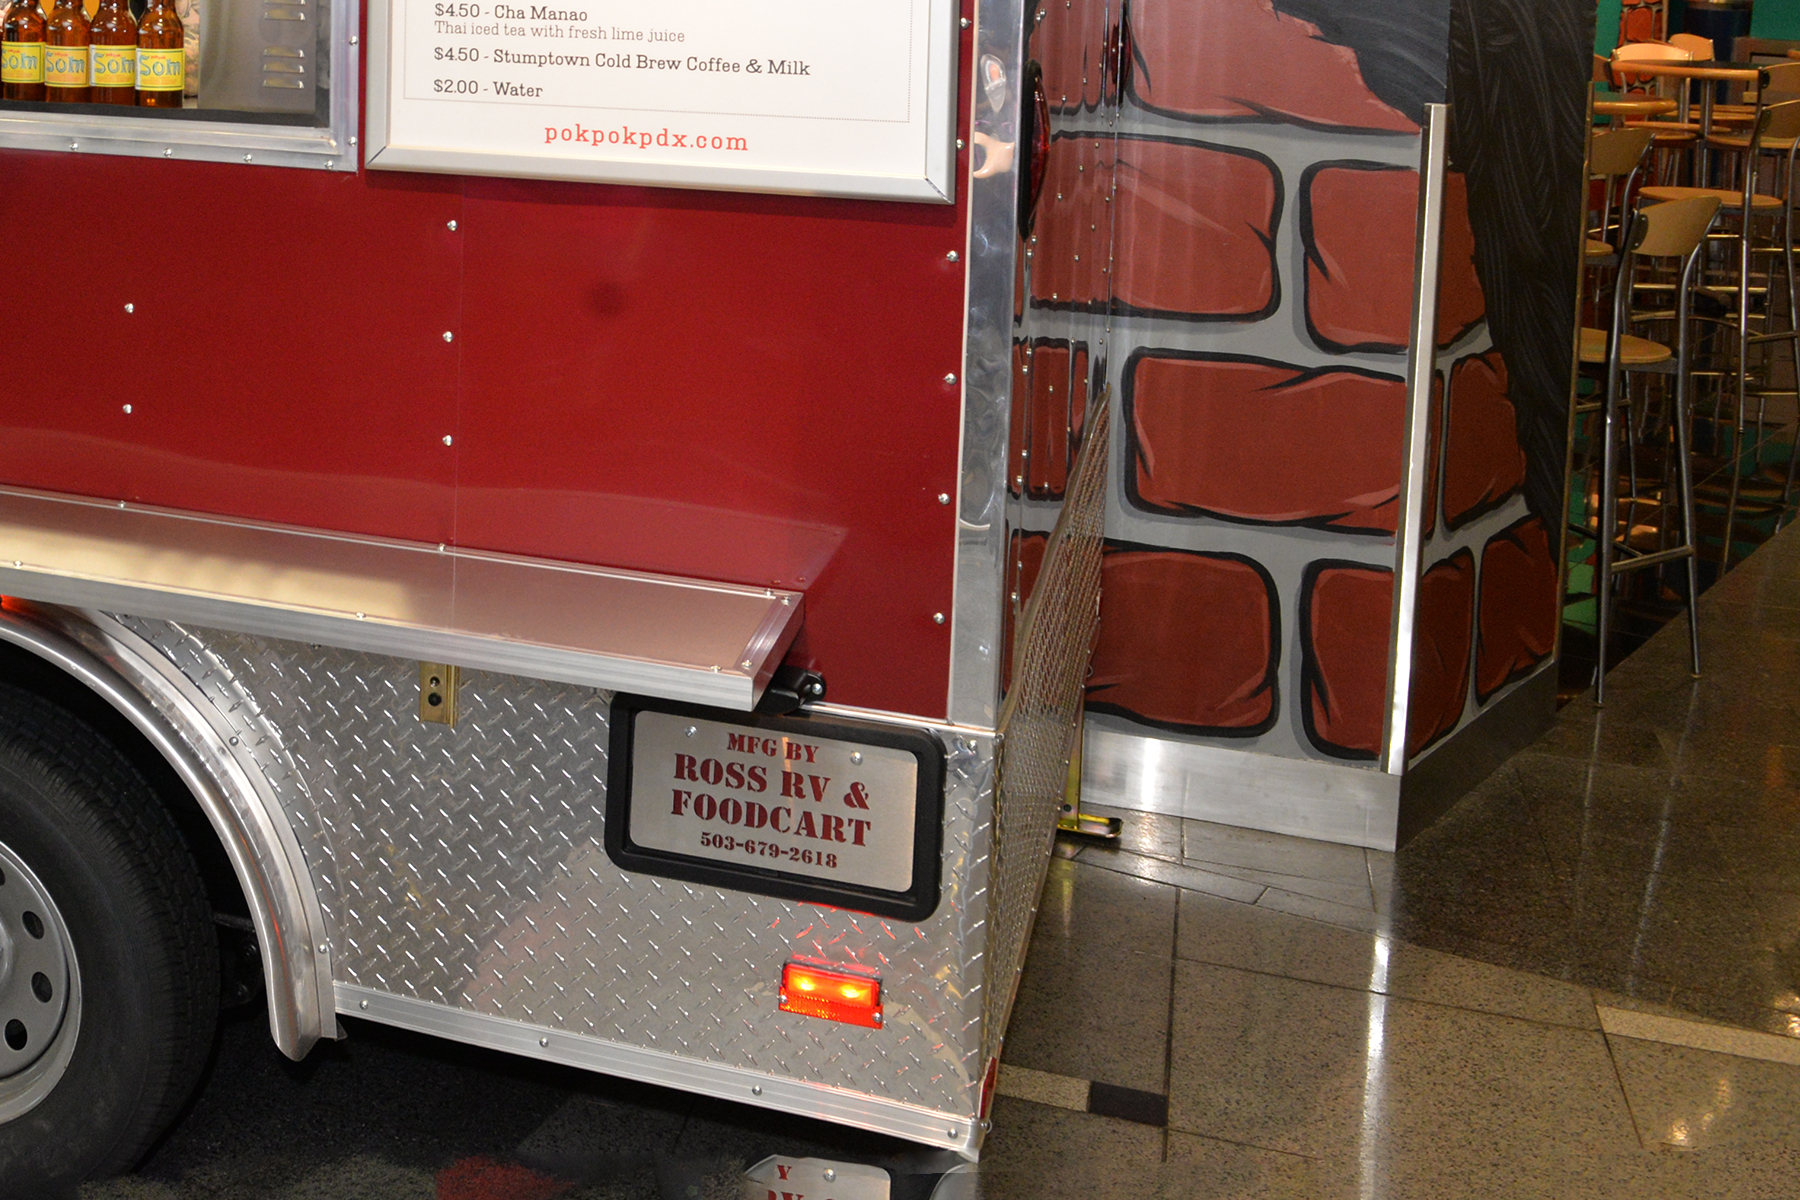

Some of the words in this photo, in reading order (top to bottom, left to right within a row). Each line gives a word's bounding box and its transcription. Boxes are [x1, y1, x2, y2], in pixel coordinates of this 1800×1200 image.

[433, 2, 480, 19] $4.50
[493, 3, 526, 20] Cha
[529, 4, 588, 22] Manao
[433, 19, 468, 35] Thai
[470, 21, 500, 36] iced
[502, 22, 527, 37] tea
[529, 23, 564, 39] with
[567, 23, 608, 40] fresh
[610, 25, 644, 42] lime
[646, 28, 685, 43] juice
[45, 51, 85, 73] Som
[93, 52, 136, 74] Som
[139, 54, 181, 76] Som
[433, 45, 480, 63] $4.50
[492, 47, 591, 67] Stumptown
[594, 51, 632, 69] Cold
[635, 53, 683, 71] Brew
[686, 55, 741, 74] Coffee
[744, 58, 763, 74] &
[766, 58, 811, 76] Milk
[433, 77, 479, 95] $2.00
[492, 80, 544, 98] Water
[543, 122, 749, 151] pokpokpdx.com
[727, 732, 778, 758] MFG
[785, 741, 819, 765] BY
[673, 752, 769, 795] ROSS
[781, 769, 831, 803] RV
[843, 781, 871, 811] &
[670, 788, 873, 847] FOODCART
[700, 830, 839, 869] 503-679-2618
